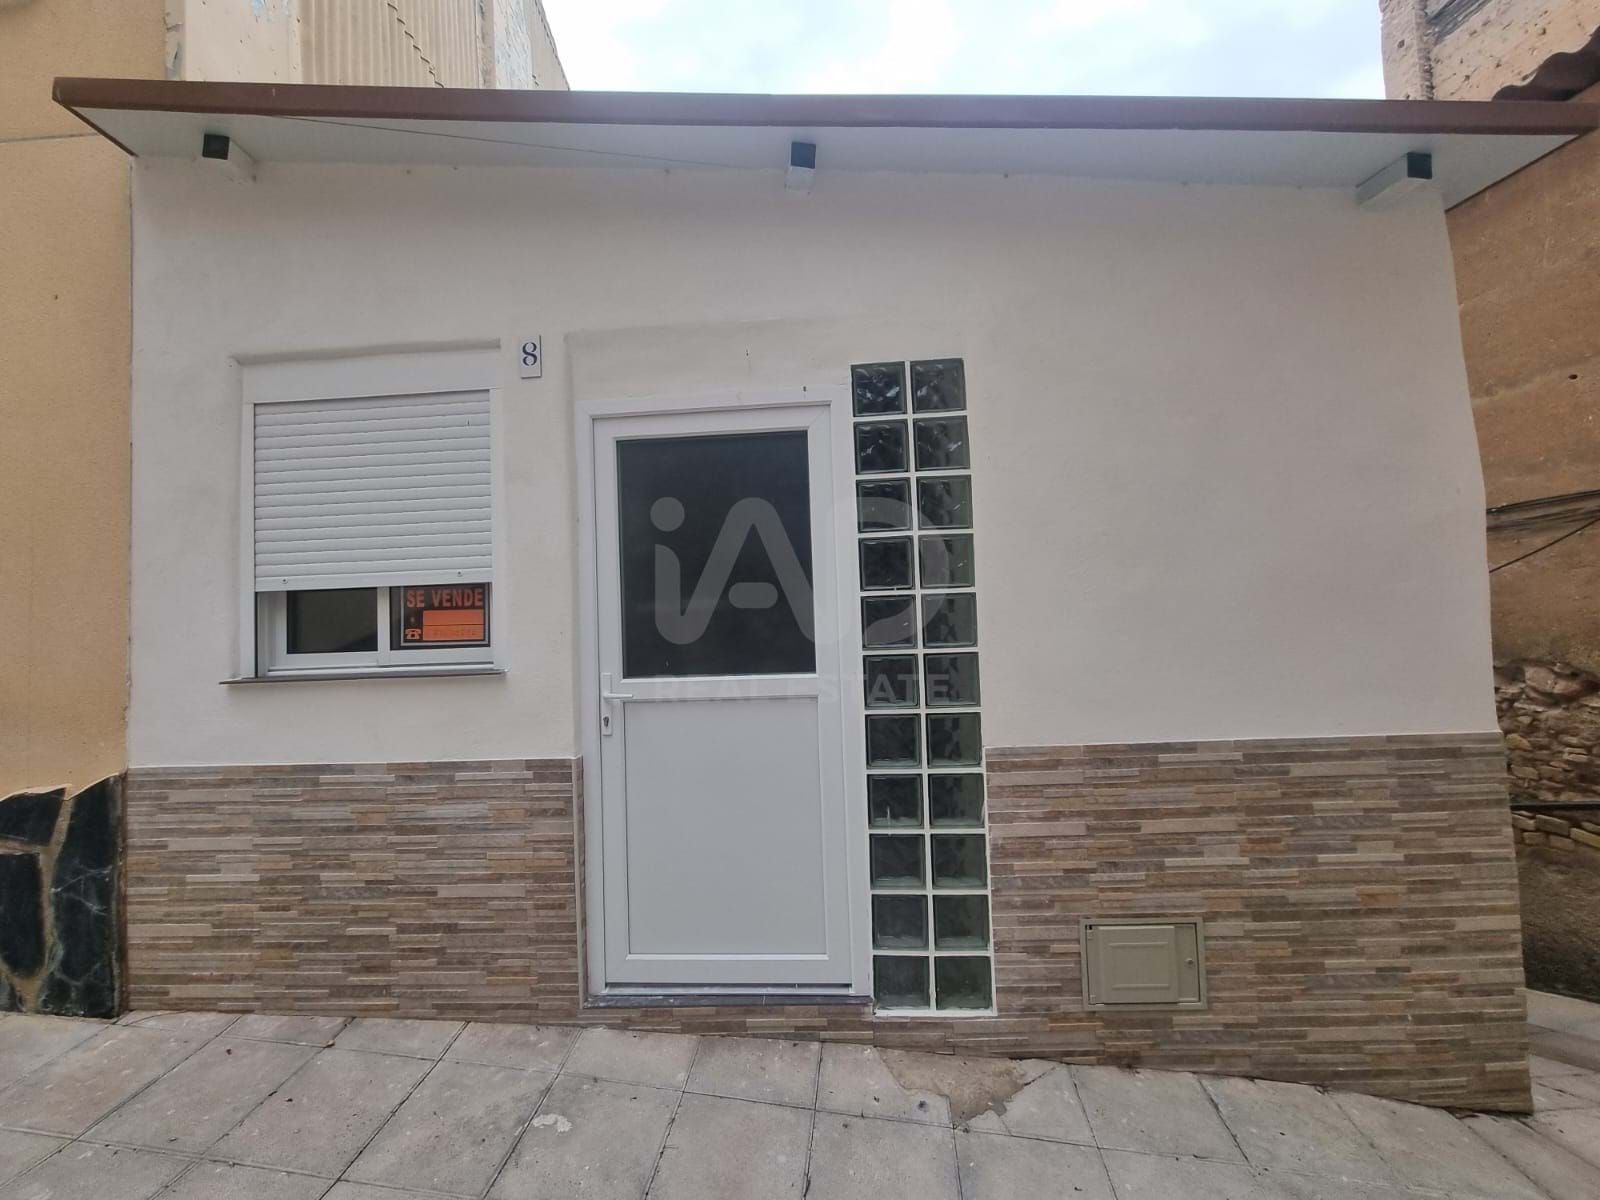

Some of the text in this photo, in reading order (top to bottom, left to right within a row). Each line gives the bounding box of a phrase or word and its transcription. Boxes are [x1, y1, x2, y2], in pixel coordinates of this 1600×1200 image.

[522, 341, 537, 366] 8
[406, 588, 483, 608] SE VENDE
